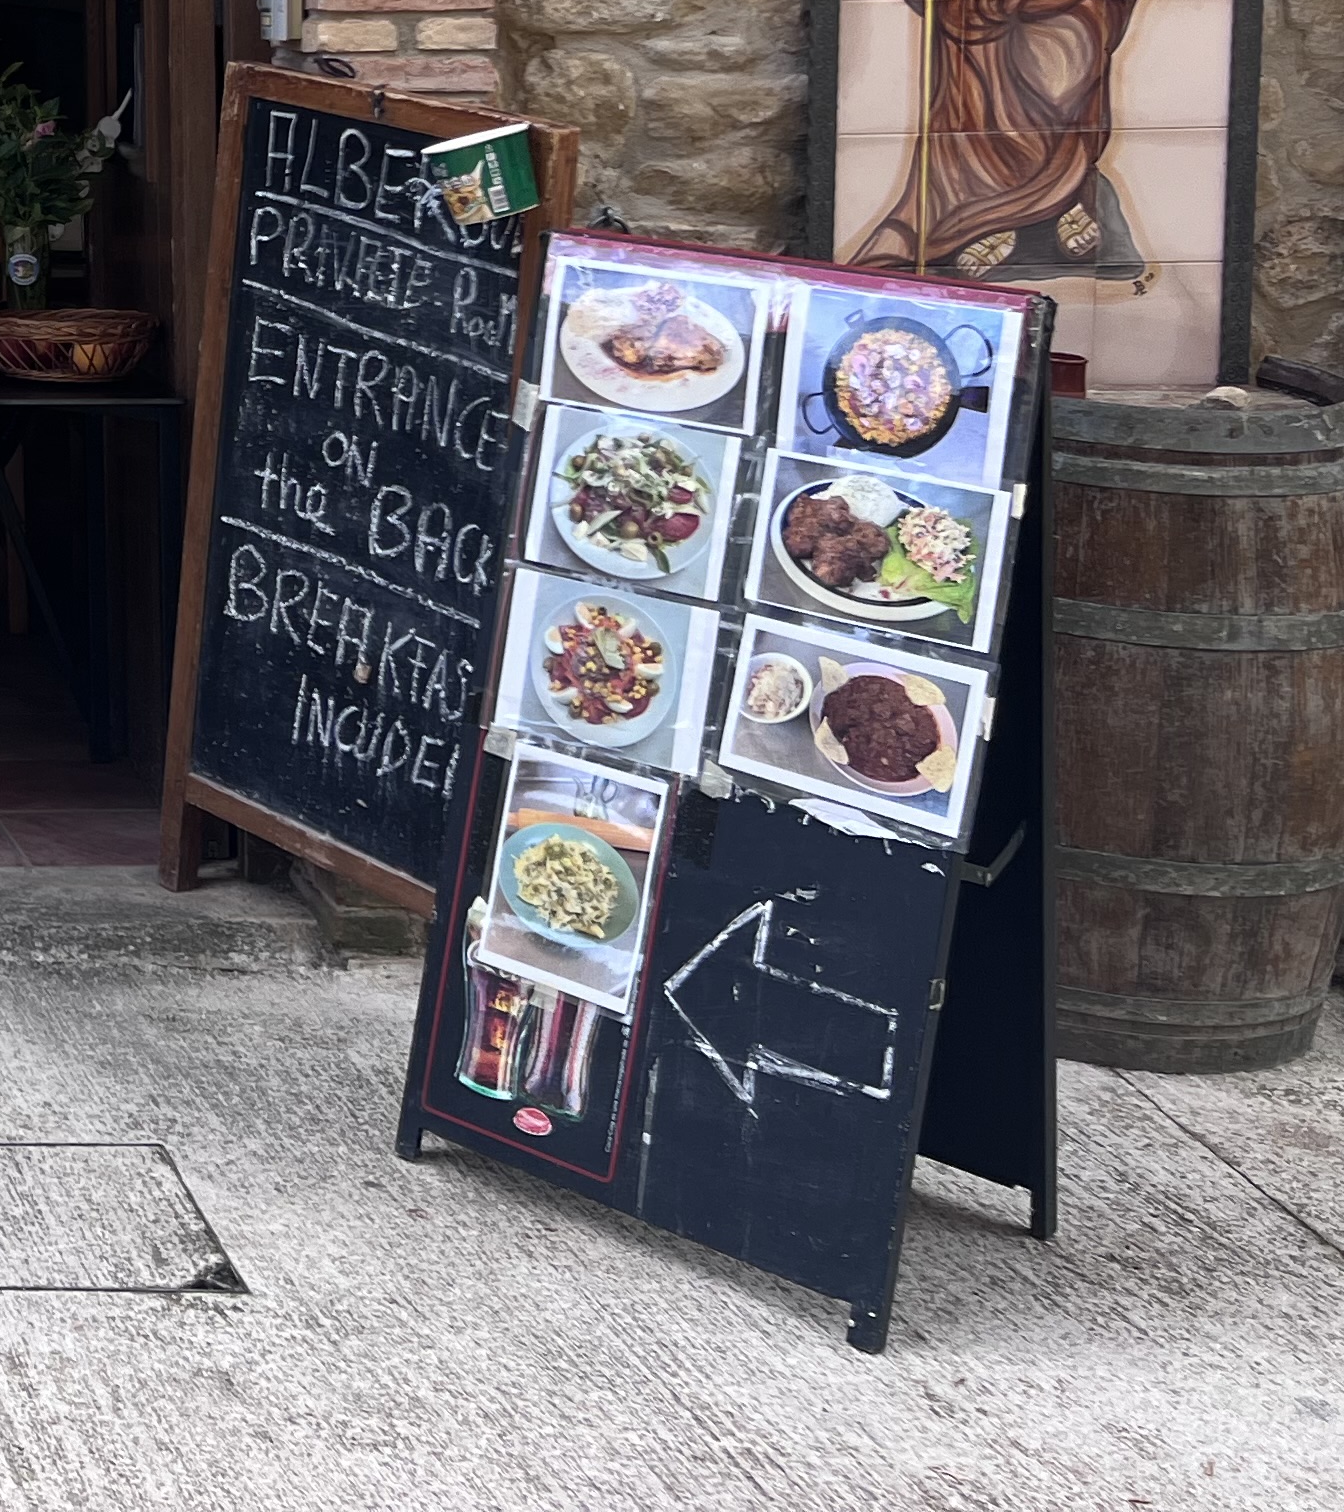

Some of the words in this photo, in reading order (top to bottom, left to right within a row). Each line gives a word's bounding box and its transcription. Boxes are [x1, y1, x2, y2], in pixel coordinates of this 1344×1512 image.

[249, 316, 508, 471] ENTRANCE
[255, 452, 335, 535] the
[322, 431, 379, 486] ON
